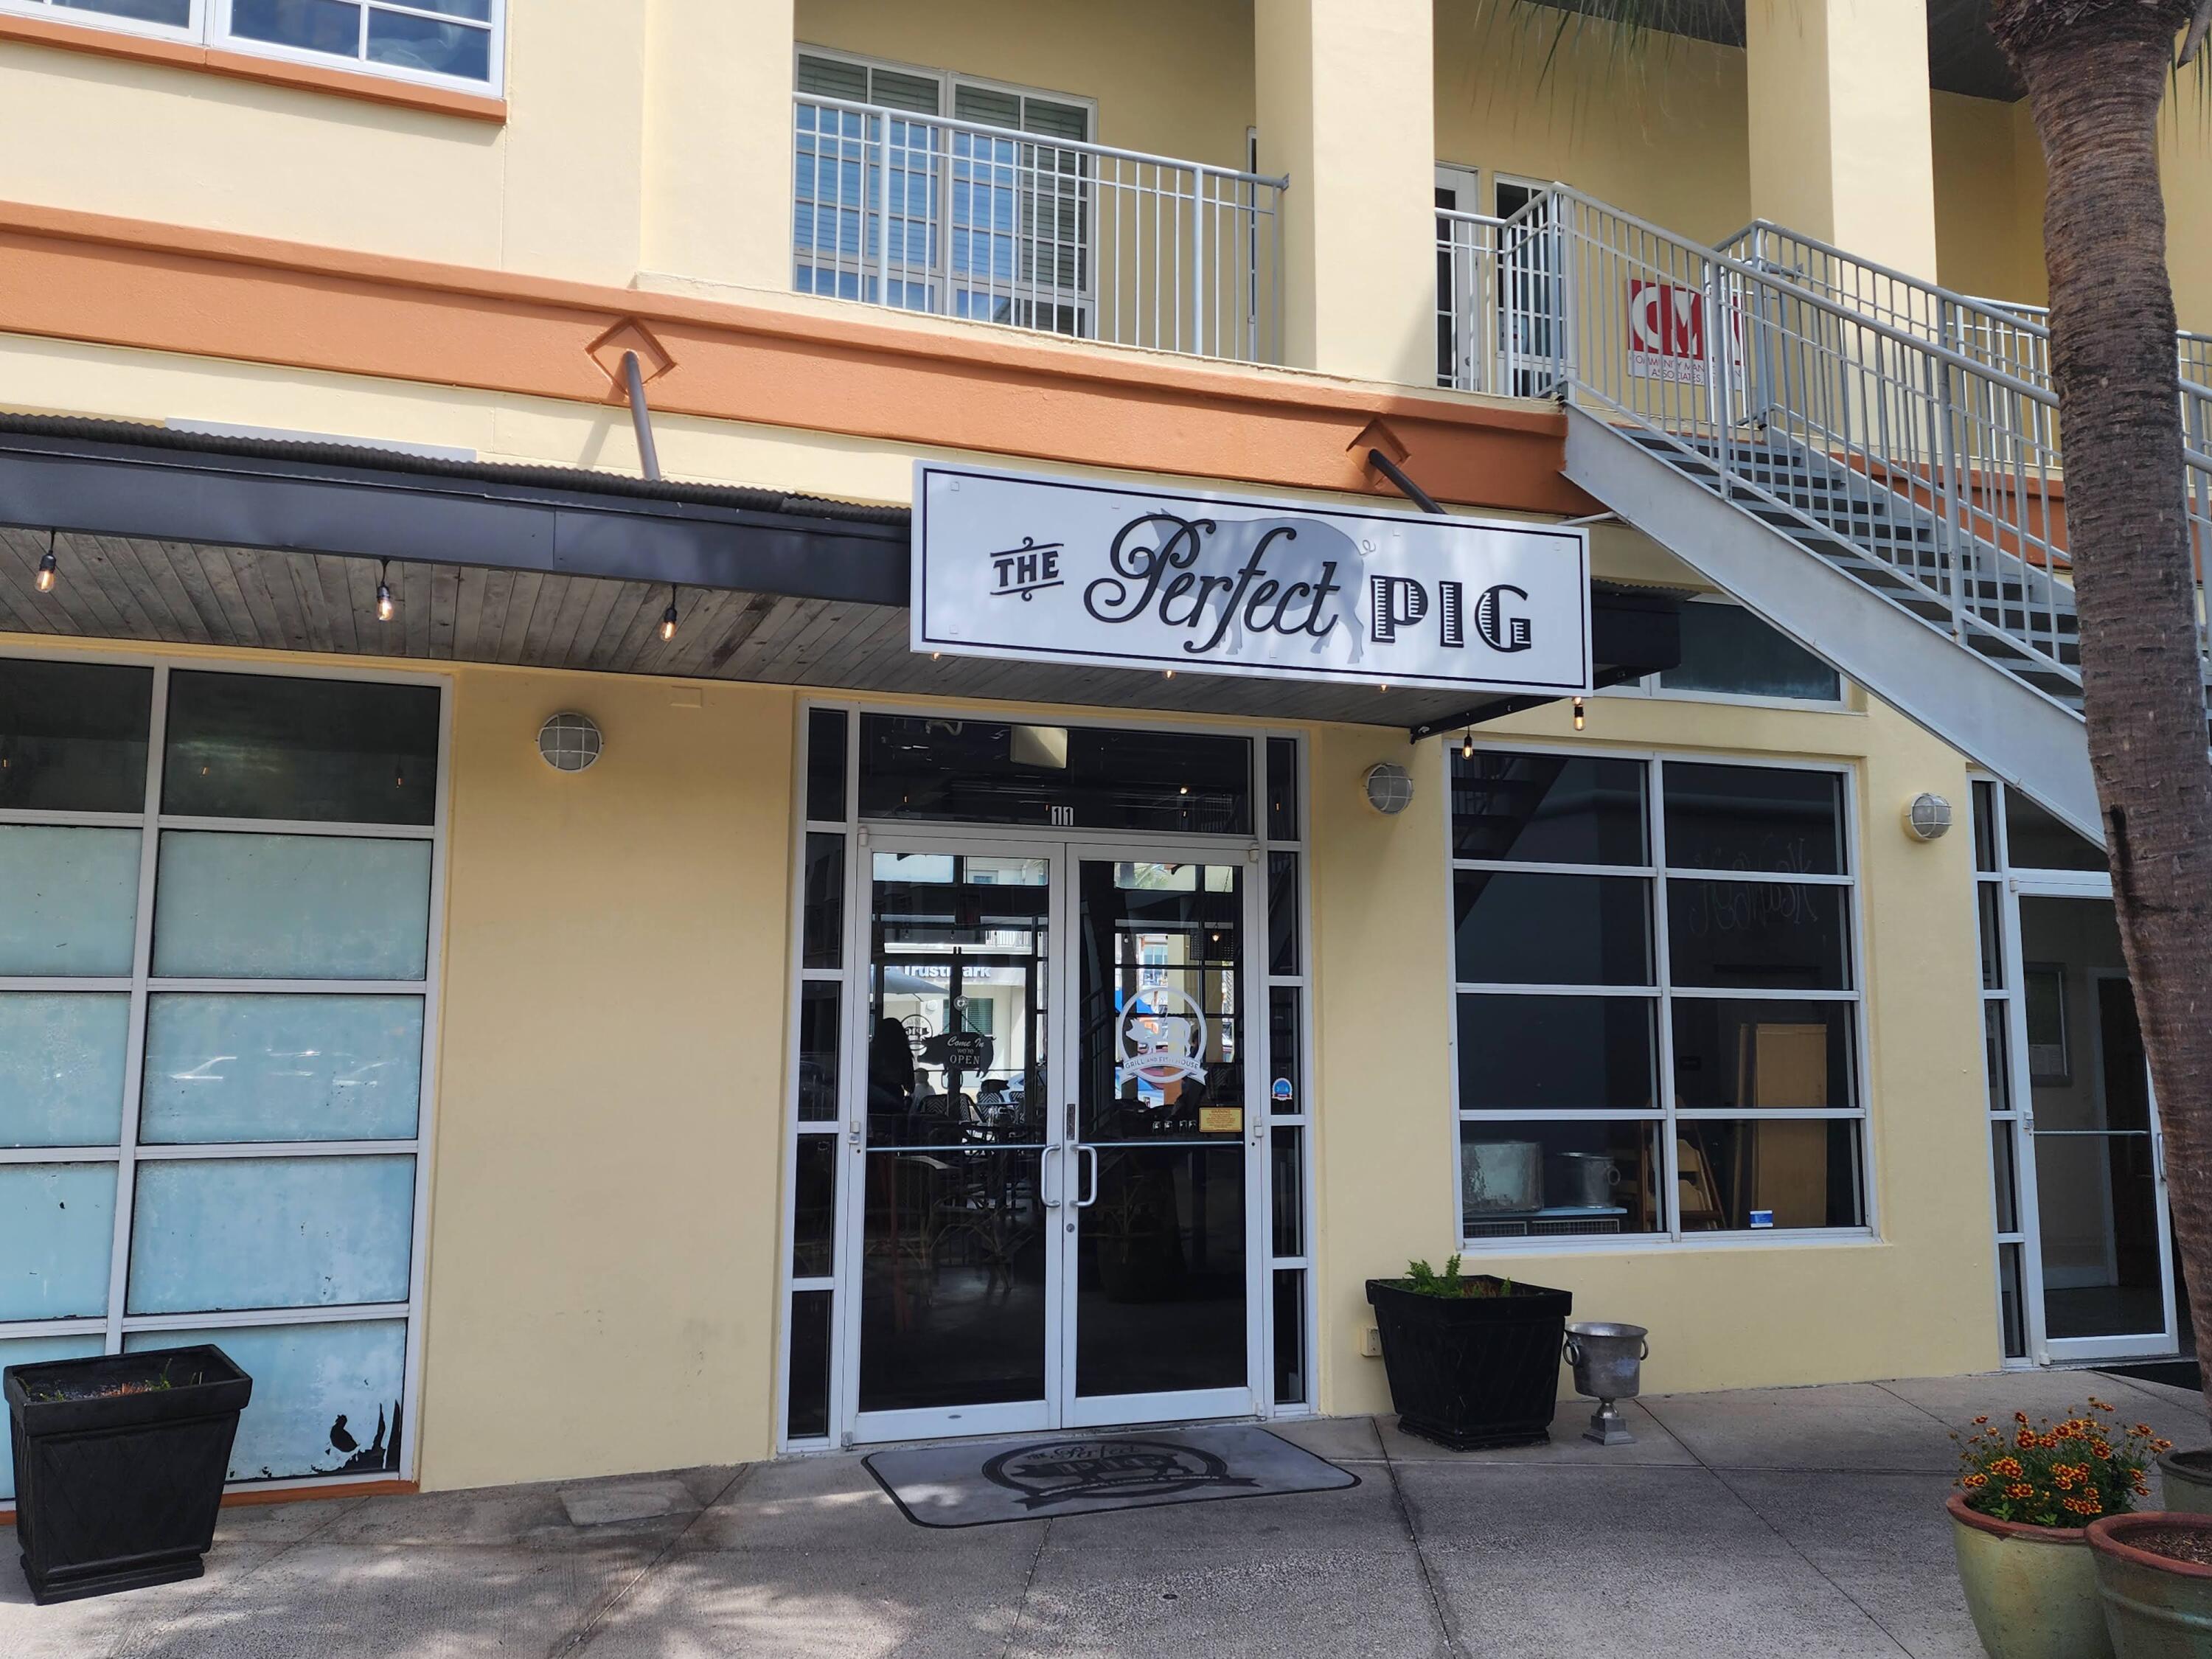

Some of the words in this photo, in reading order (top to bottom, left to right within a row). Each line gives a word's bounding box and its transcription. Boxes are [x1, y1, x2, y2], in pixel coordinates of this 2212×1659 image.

[993, 550, 1060, 587] THE
[1083, 514, 1341, 653] Perfect
[1370, 574, 1532, 653] PIG
[947, 1036, 971, 1047] Come
[975, 1037, 984, 1048] In
[950, 1055, 980, 1065] OPEN
[1125, 1059, 1144, 1069] GRILL
